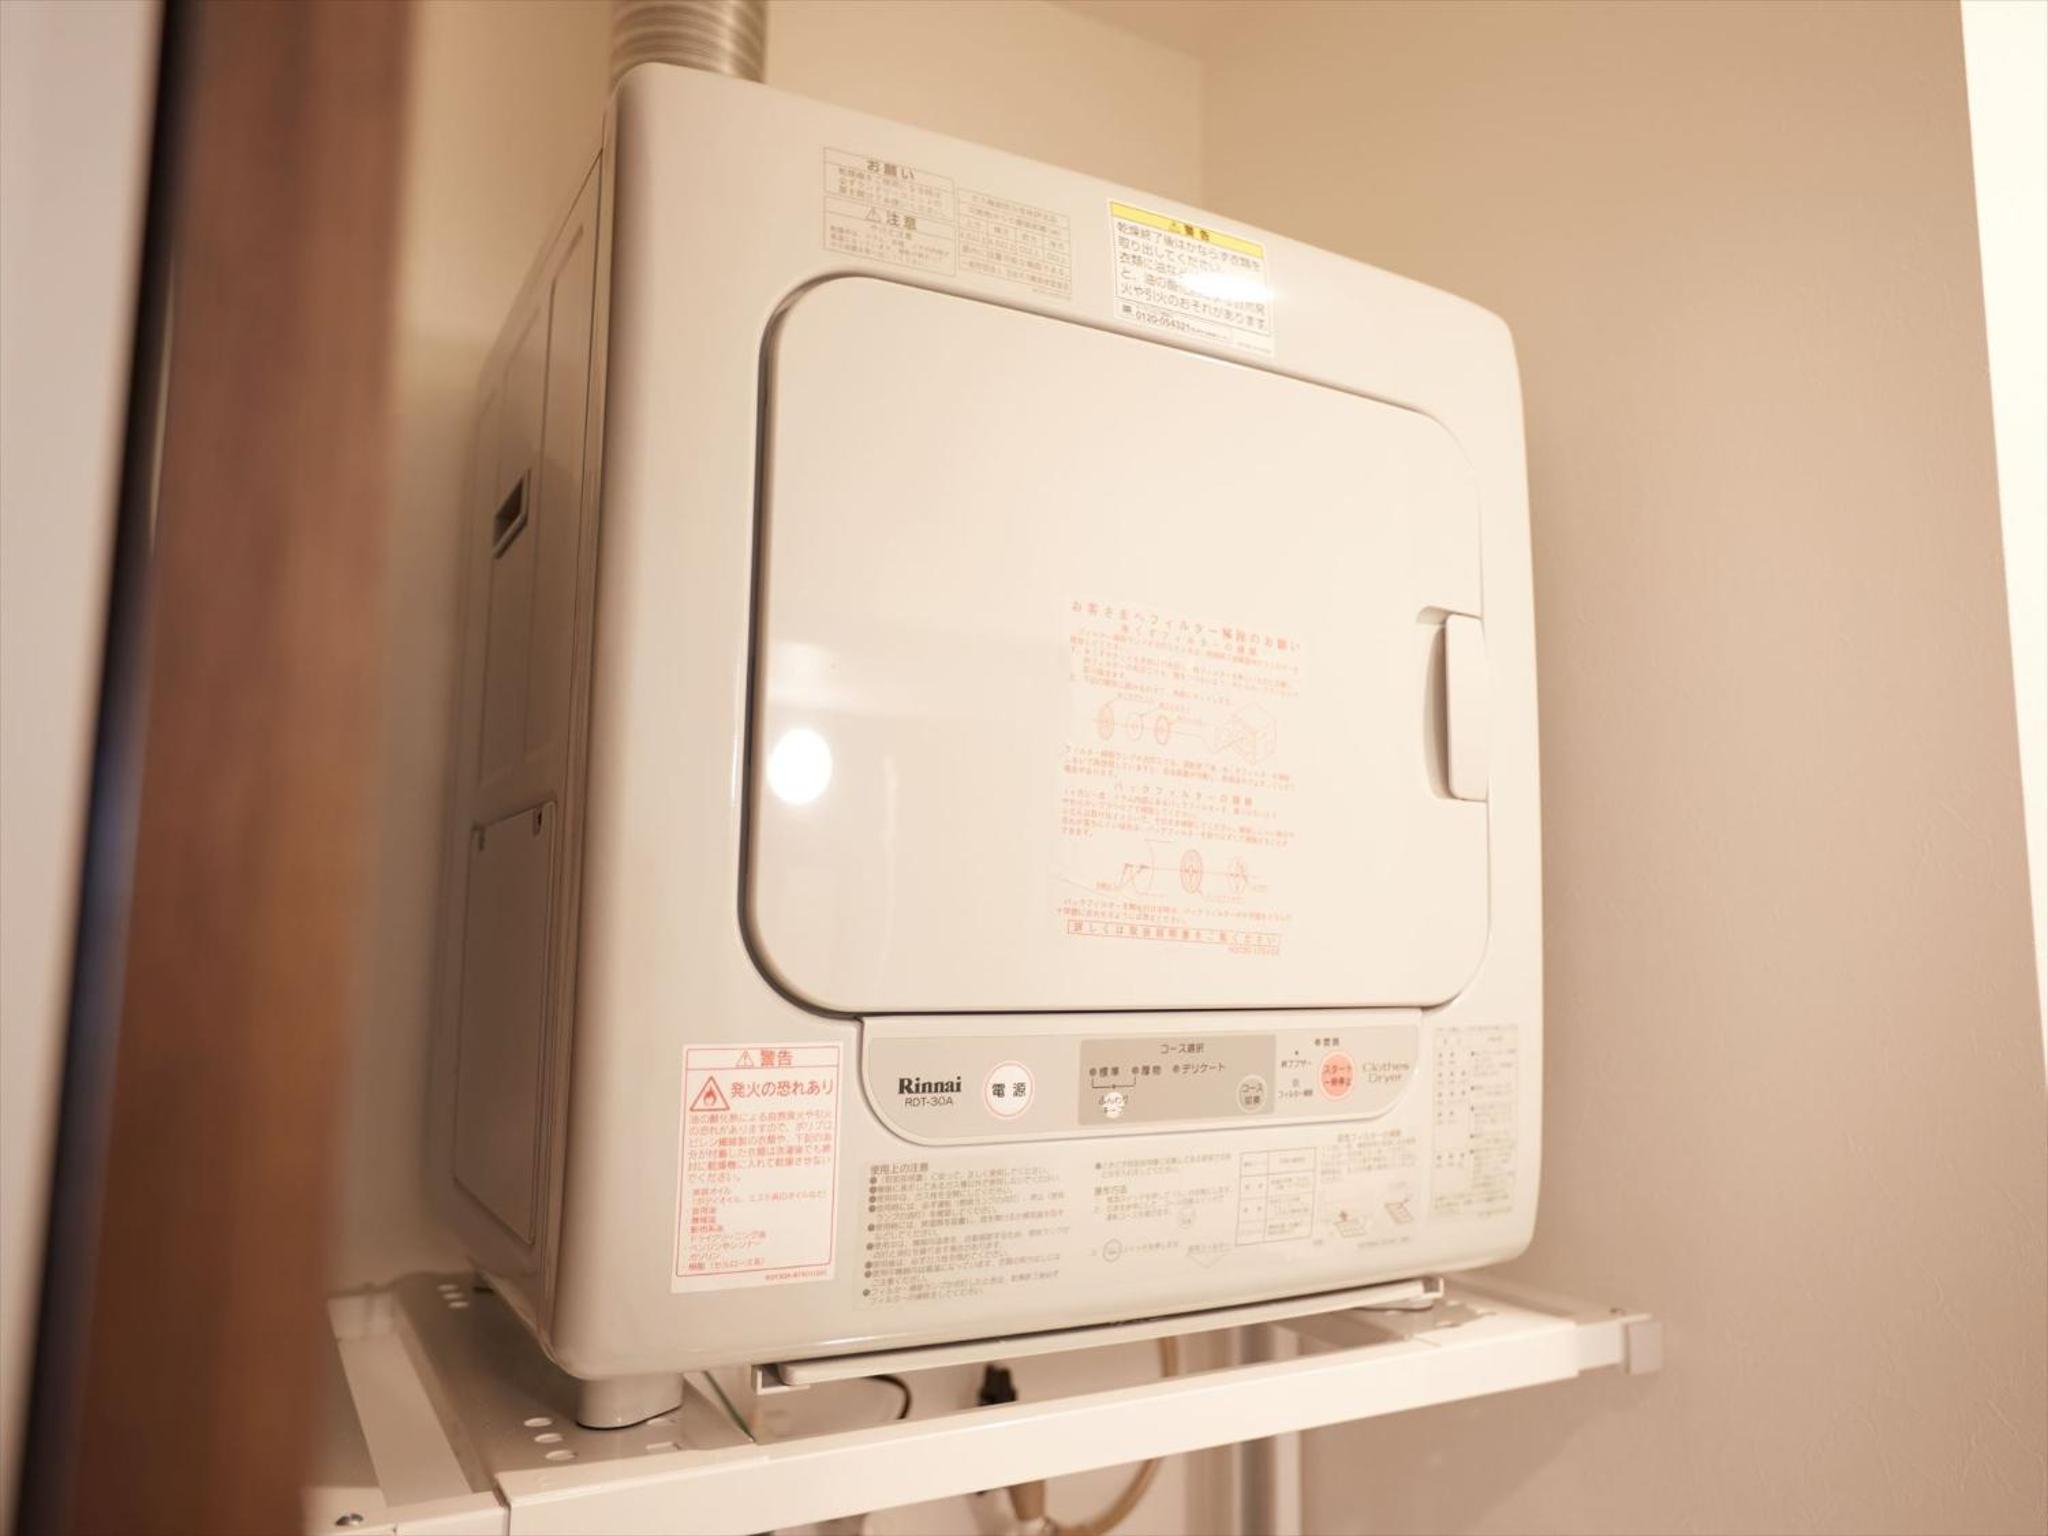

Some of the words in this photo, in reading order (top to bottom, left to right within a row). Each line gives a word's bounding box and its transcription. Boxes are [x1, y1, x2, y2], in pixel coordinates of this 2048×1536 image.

[886, 210, 916, 230] 注意
[1160, 1042, 1205, 1054] コース選択
[760, 1050, 793, 1067] 警告
[1099, 1066, 1120, 1077] 標準
[1182, 1062, 1225, 1074] デリケート
[1368, 1073, 1402, 1084] Dryer
[731, 1079, 833, 1098] 発火の恐れあり
[898, 1076, 962, 1095] Rinnai
[992, 1082, 1026, 1098] 電源
[1241, 1083, 1263, 1093] コース
[904, 1096, 954, 1108] RDT-30A
[870, 1162, 929, 1175] 使用上の注意
